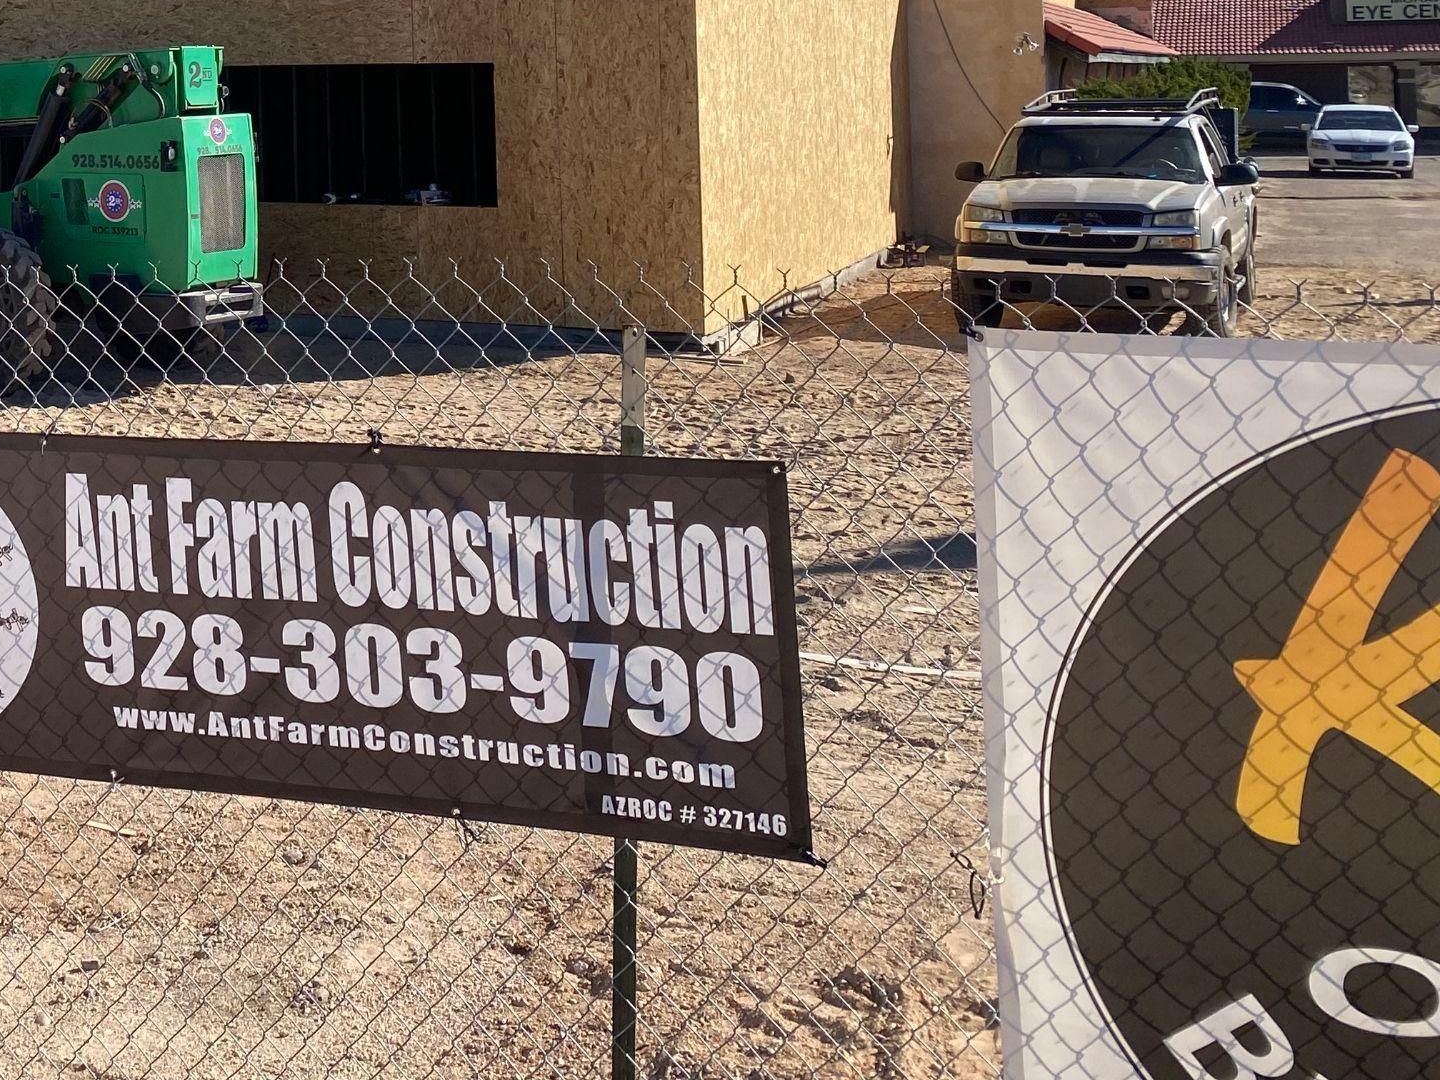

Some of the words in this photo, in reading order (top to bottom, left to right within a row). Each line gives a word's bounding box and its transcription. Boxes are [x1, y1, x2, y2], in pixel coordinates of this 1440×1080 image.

[1352, 5, 1393, 20] EYE
[71, 154, 160, 170] 928.514.0656
[65, 472, 159, 594] Ant
[165, 476, 319, 603] Farm
[328, 480, 775, 636] Construction
[81, 605, 764, 743] 928-303-9790
[112, 705, 736, 790] www.AntFarmConstruction.com
[601, 794, 673, 822] AZROC
[679, 805, 697, 824] #
[703, 805, 788, 838] 327146
